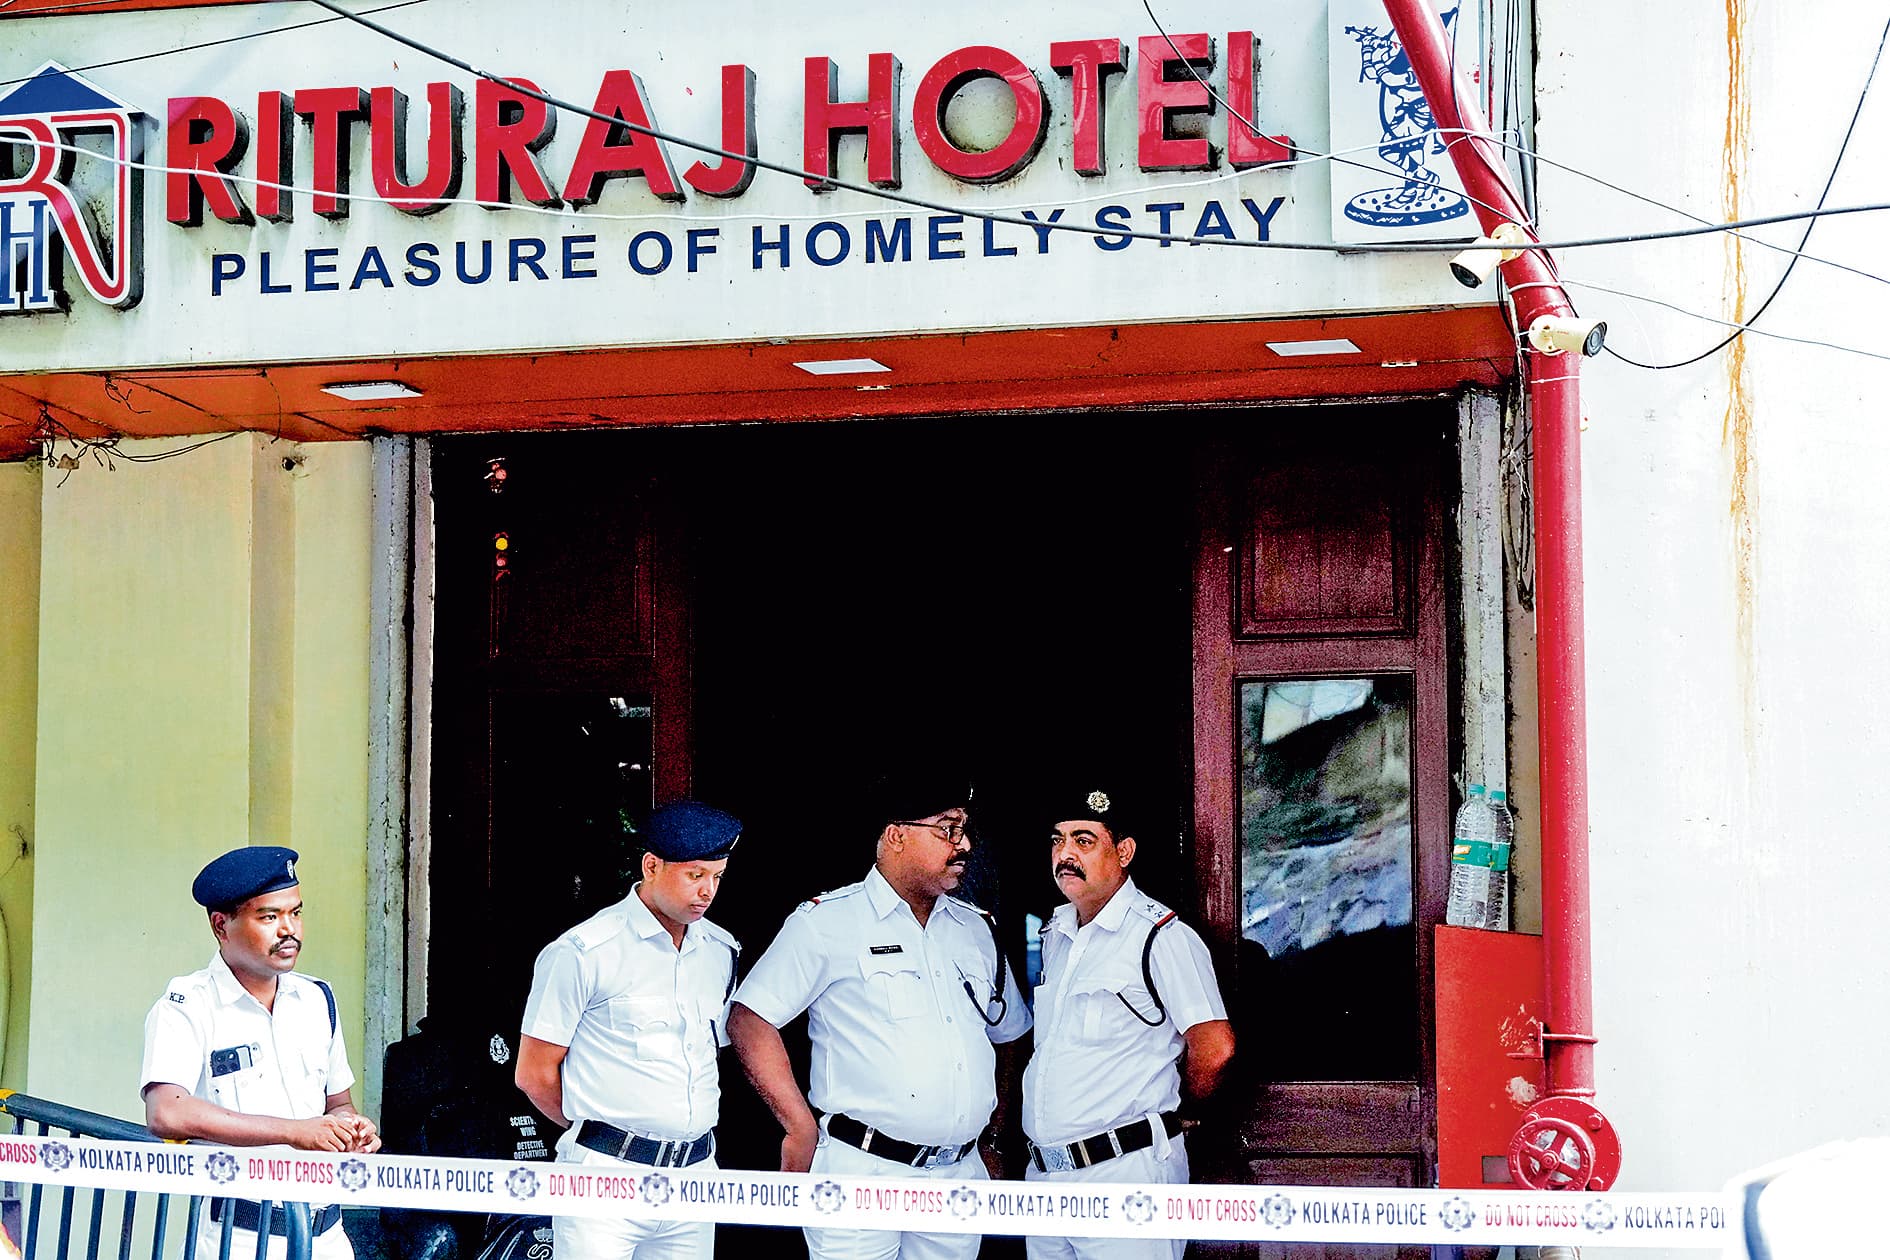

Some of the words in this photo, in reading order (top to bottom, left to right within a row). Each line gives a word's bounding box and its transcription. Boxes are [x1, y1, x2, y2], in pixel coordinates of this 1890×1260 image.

[167, 64, 757, 227] RITURAJ
[803, 30, 1297, 192] HOTEL
[211, 233, 599, 297] PLEASURE
[627, 226, 720, 276] OF
[751, 207, 1066, 270] HOMELY
[1093, 195, 1287, 252] STAY
[0, 1142, 37, 1164] CROSS
[78, 1148, 143, 1173] KOLKATA
[146, 1153, 195, 1177] POLICE
[248, 1157, 265, 1181] DO
[267, 1159, 292, 1182] NOT
[294, 1161, 334, 1185] CROSS
[376, 1166, 441, 1190] KOLKATA
[446, 1170, 494, 1194] POLICE
[549, 1174, 565, 1196] DO
[569, 1175, 593, 1198] NOT
[596, 1177, 636, 1200] CROSS
[680, 1180, 745, 1205] KOLKATA
[750, 1184, 800, 1208] POLICE
[855, 1188, 871, 1210] DO
[875, 1189, 900, 1211] NOT
[903, 1190, 943, 1213] CROSS
[988, 1193, 1054, 1217] KOLKATA
[1060, 1196, 1110, 1219] POLICE
[1167, 1198, 1183, 1221] DO
[1187, 1199, 1212, 1221] NOT
[1215, 1200, 1257, 1222] CROSS
[1302, 1202, 1371, 1225] KOLKATA
[1376, 1203, 1428, 1226] POLICE
[1485, 1204, 1502, 1227] DO
[1506, 1205, 1531, 1227] NOT
[1535, 1205, 1578, 1228] CROSS
[1625, 1206, 1695, 1229] KOLKATA
[513, 1149, 548, 1160] DEPARTMENT
[516, 1140, 544, 1151] DETECTIVE
